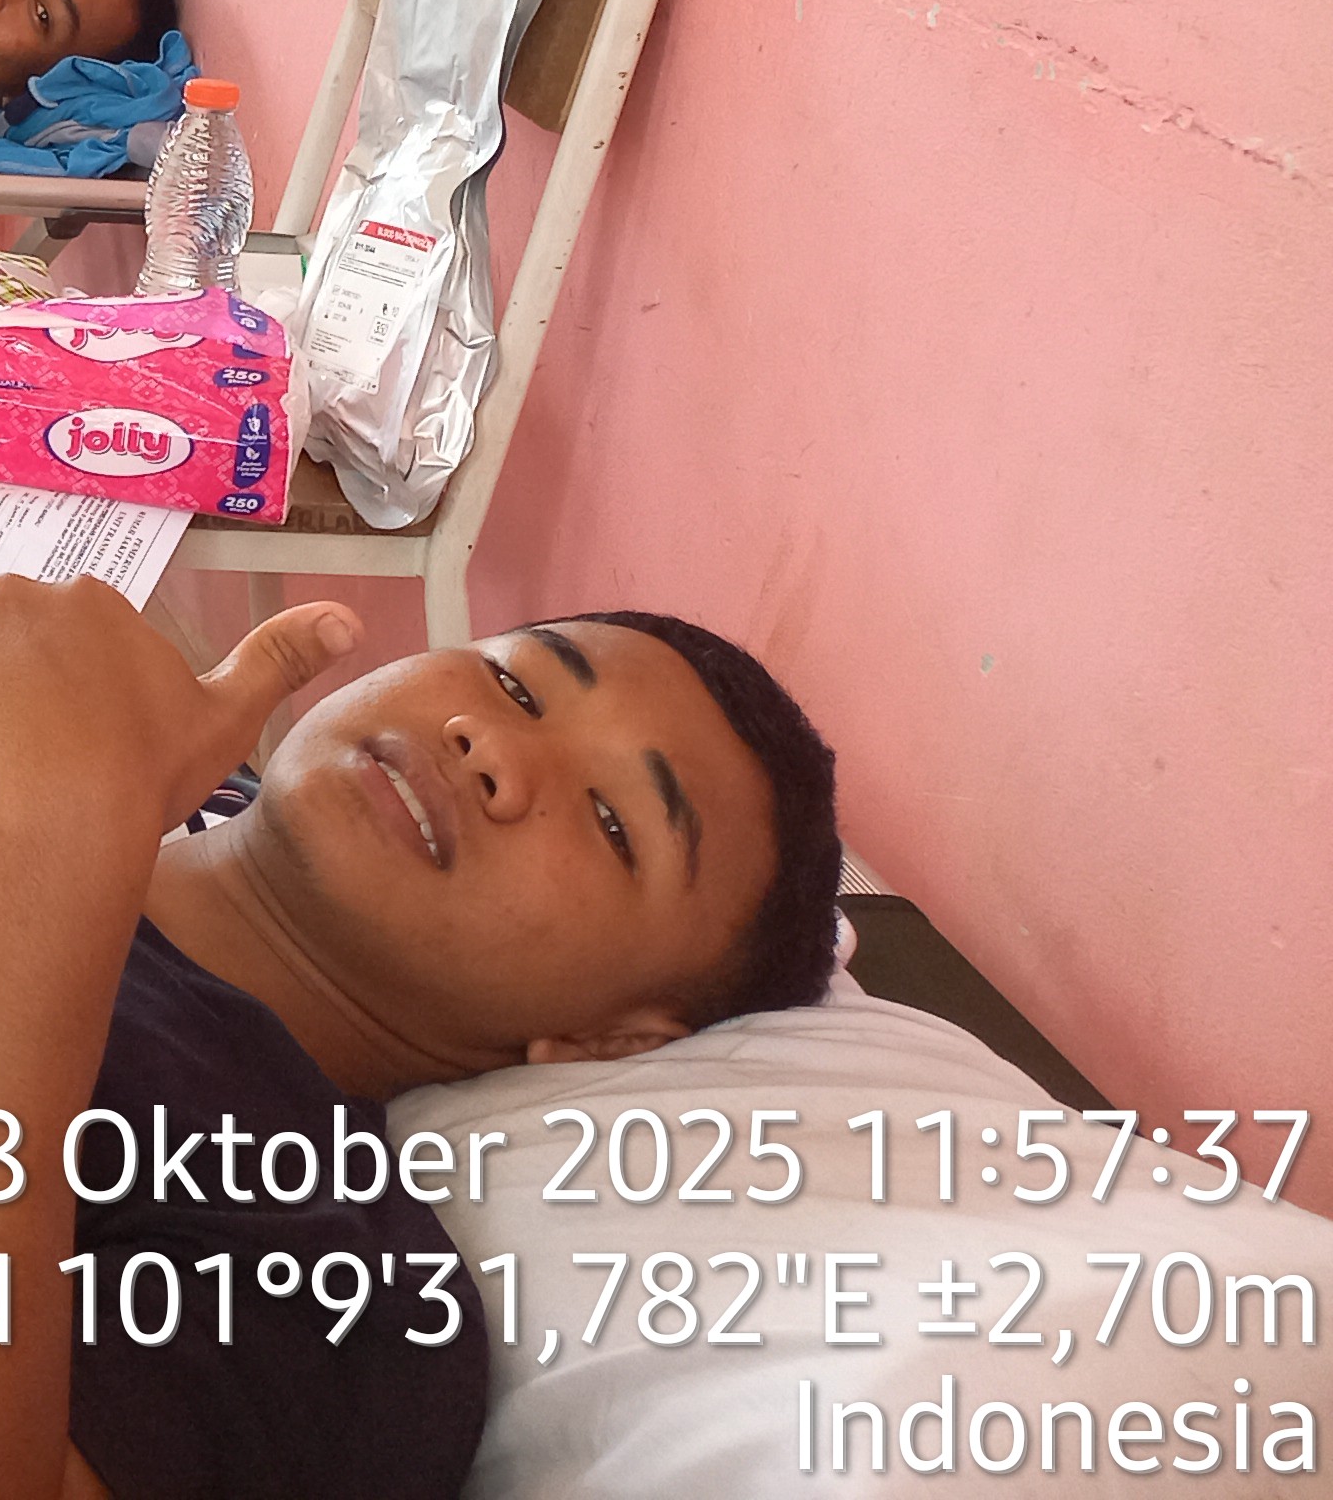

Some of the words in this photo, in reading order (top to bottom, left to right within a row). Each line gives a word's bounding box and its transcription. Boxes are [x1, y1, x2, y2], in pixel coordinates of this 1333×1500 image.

[221, 368, 263, 381] 250
[66, 417, 172, 464] jolly
[225, 497, 258, 510] 250
